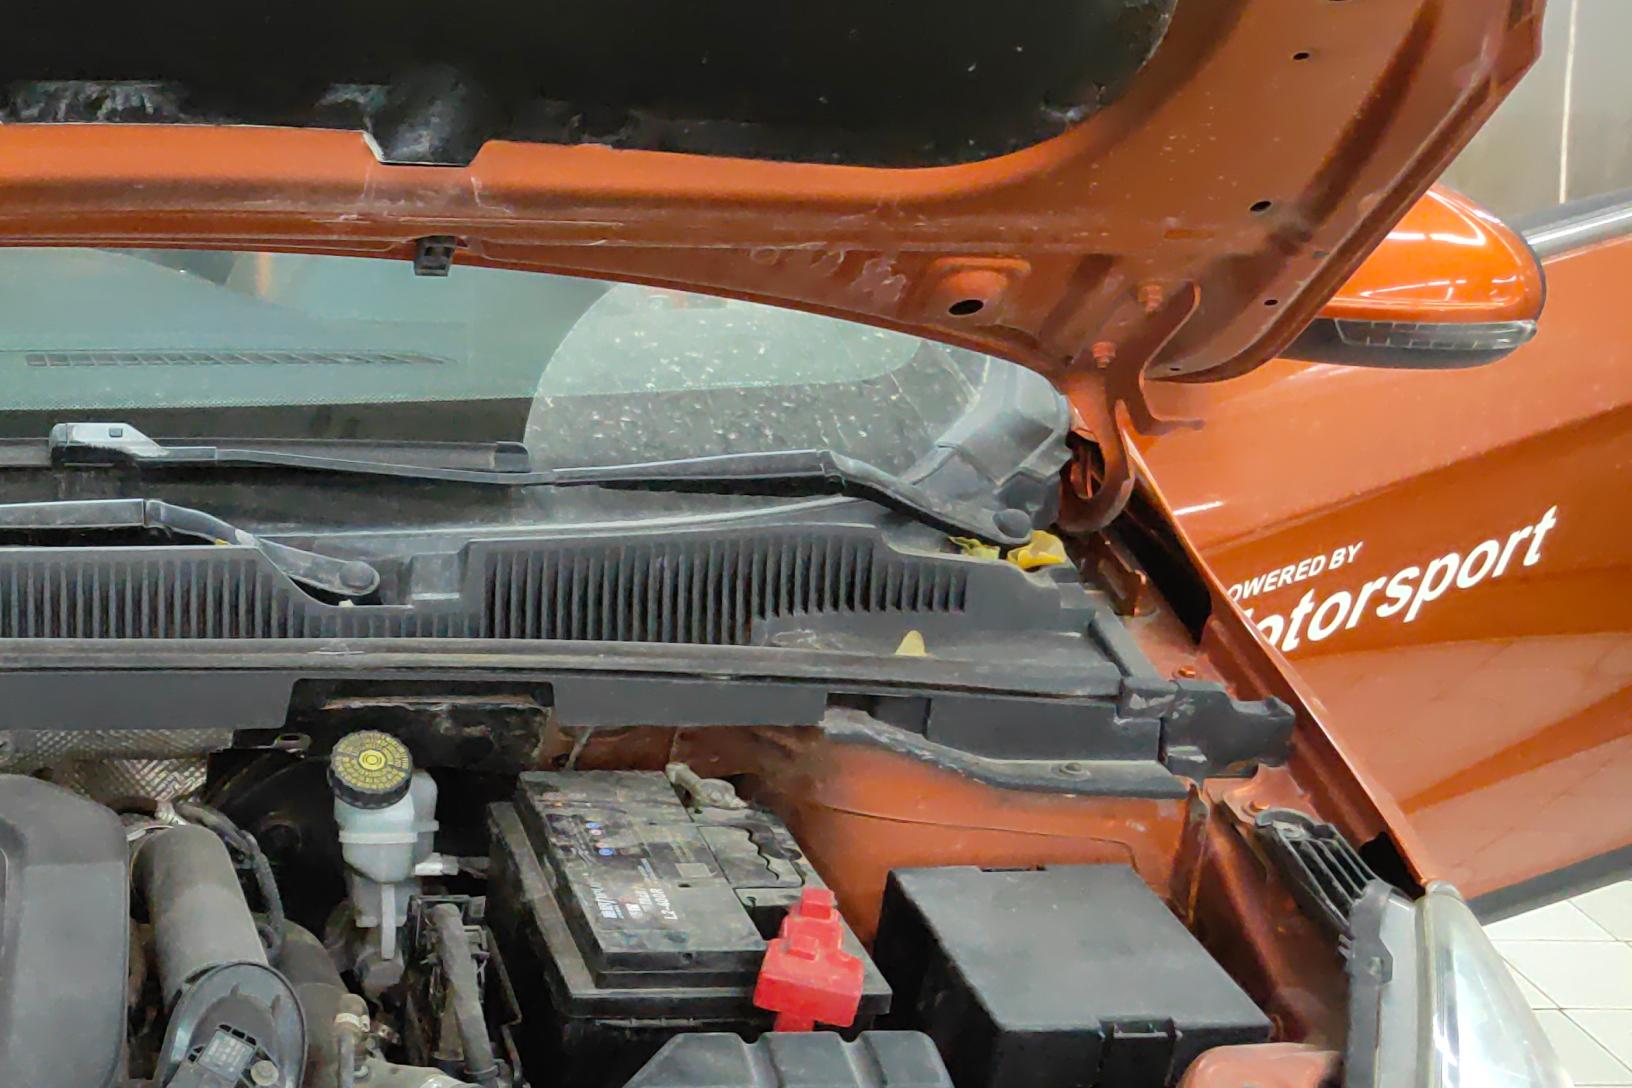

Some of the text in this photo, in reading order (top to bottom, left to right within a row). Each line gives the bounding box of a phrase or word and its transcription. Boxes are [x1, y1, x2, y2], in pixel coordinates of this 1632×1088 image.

[1225, 541, 1364, 602] OWERED BY
[1240, 505, 1557, 652] otorsport
